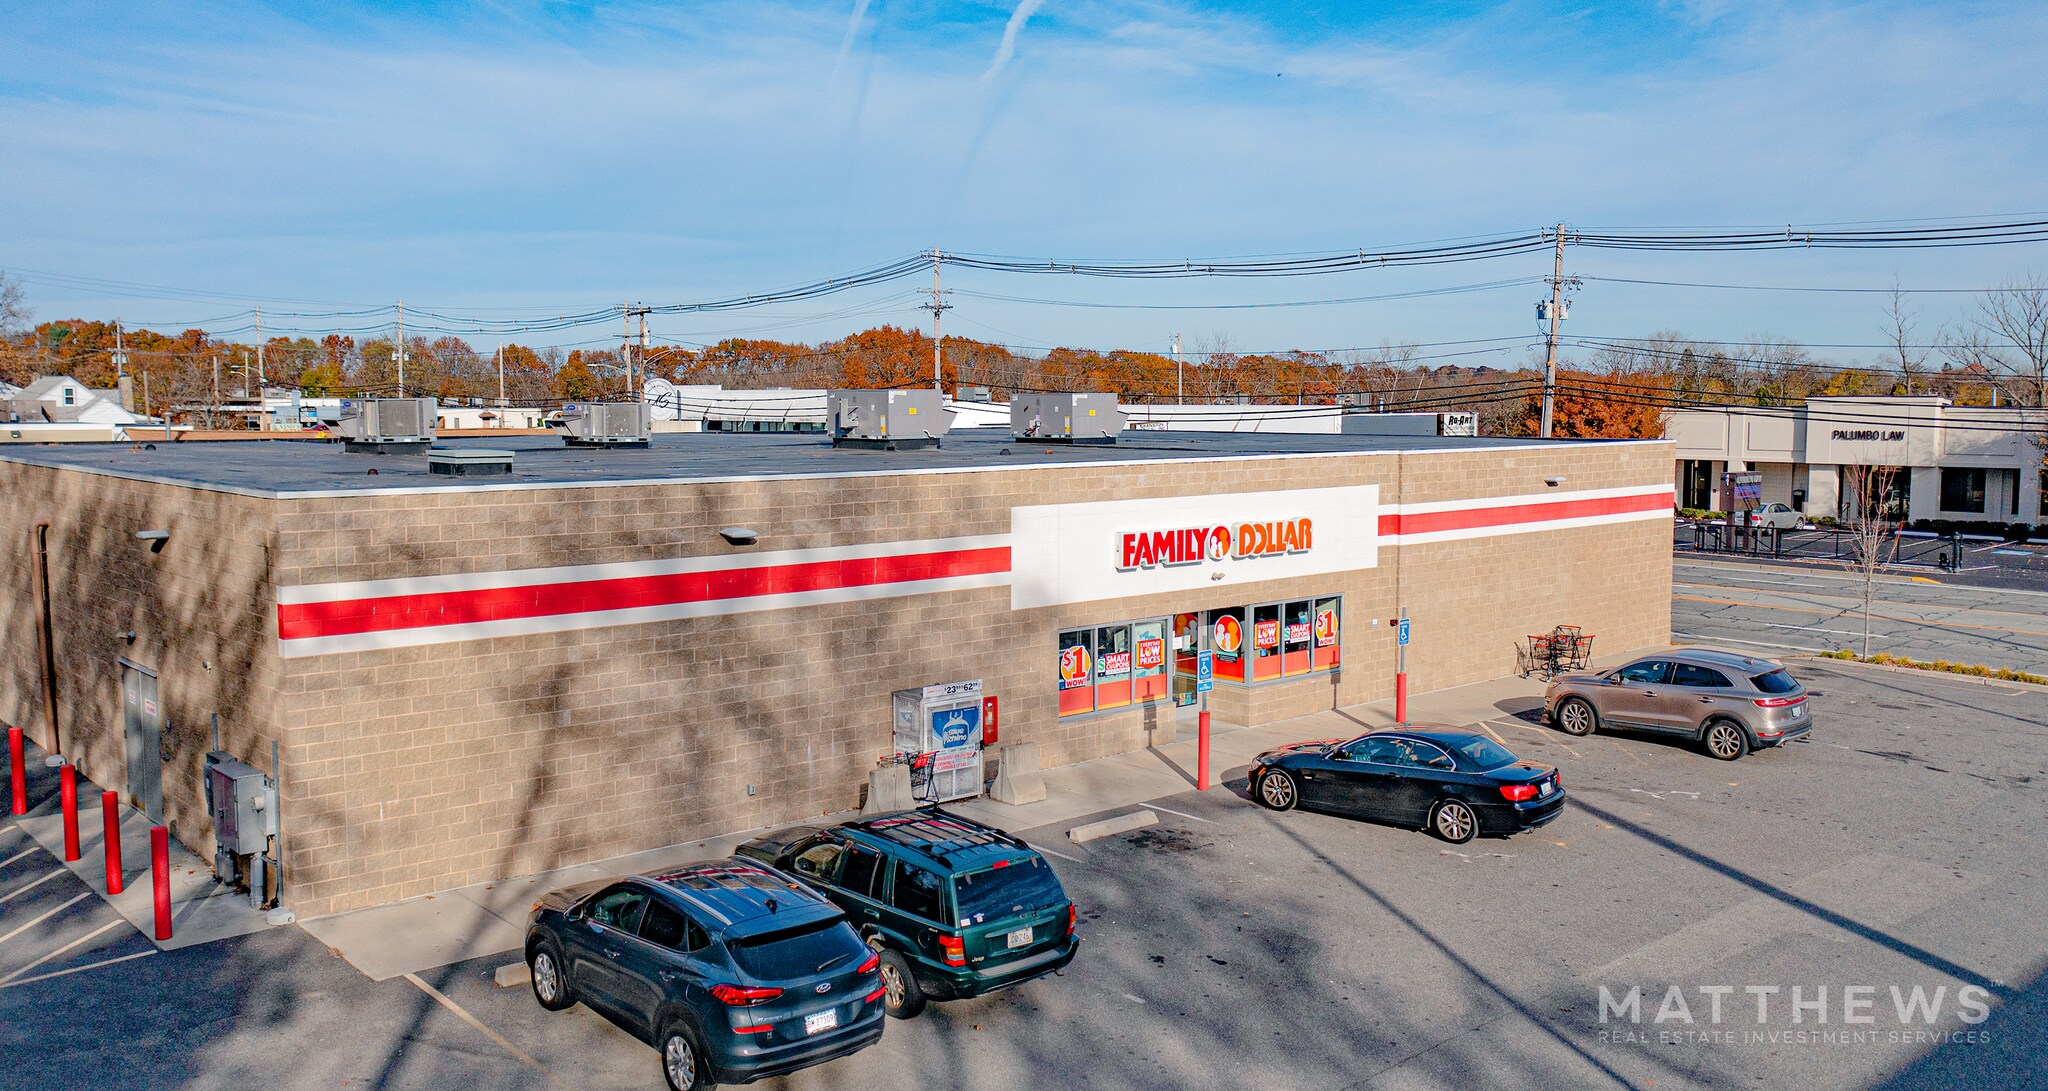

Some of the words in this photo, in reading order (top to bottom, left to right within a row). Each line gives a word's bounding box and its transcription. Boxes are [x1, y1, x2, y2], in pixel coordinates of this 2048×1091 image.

[1832, 430, 1879, 441] PALUMBO
[1881, 431, 1905, 441] LAW
[1122, 528, 1209, 567] FAMILY
[1238, 518, 1313, 556] DOLLAR
[1258, 637, 1276, 645] PRICES
[1140, 646, 1160, 657] LOW
[1063, 647, 1086, 678] $1
[1106, 653, 1129, 663] SMART
[1140, 656, 1160, 665] PRICES
[1106, 661, 1129, 670] COUPONS
